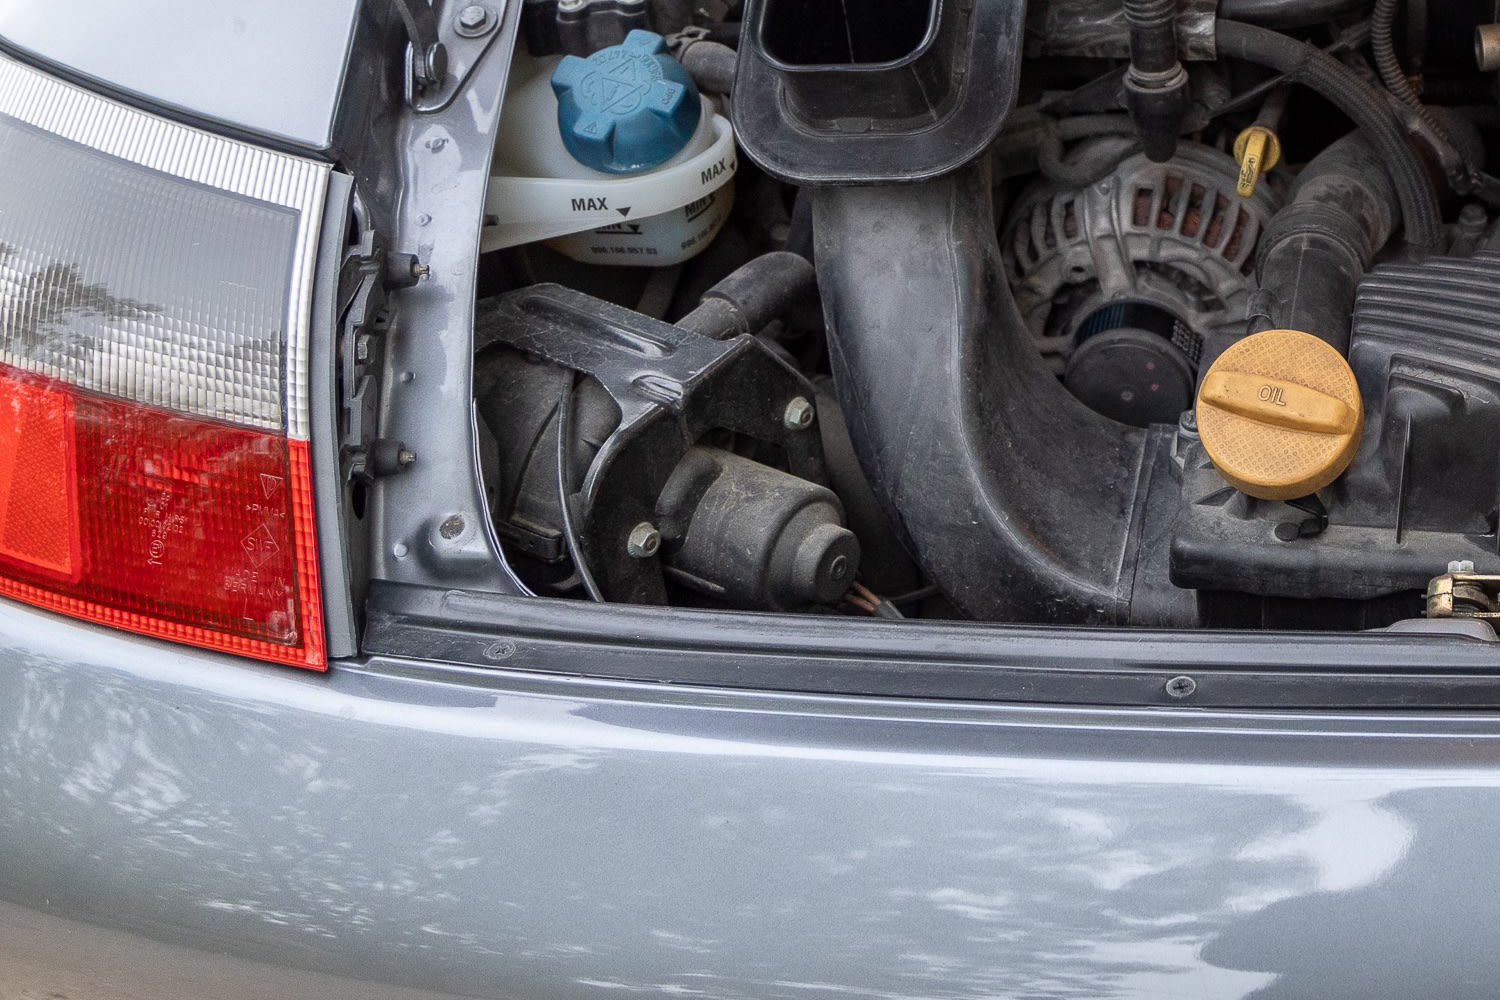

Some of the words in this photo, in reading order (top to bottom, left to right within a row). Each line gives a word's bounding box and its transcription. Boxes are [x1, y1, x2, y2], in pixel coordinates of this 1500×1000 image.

[700, 158, 728, 185] MAX
[571, 197, 609, 212] MAX
[1257, 385, 1287, 407] OIL
